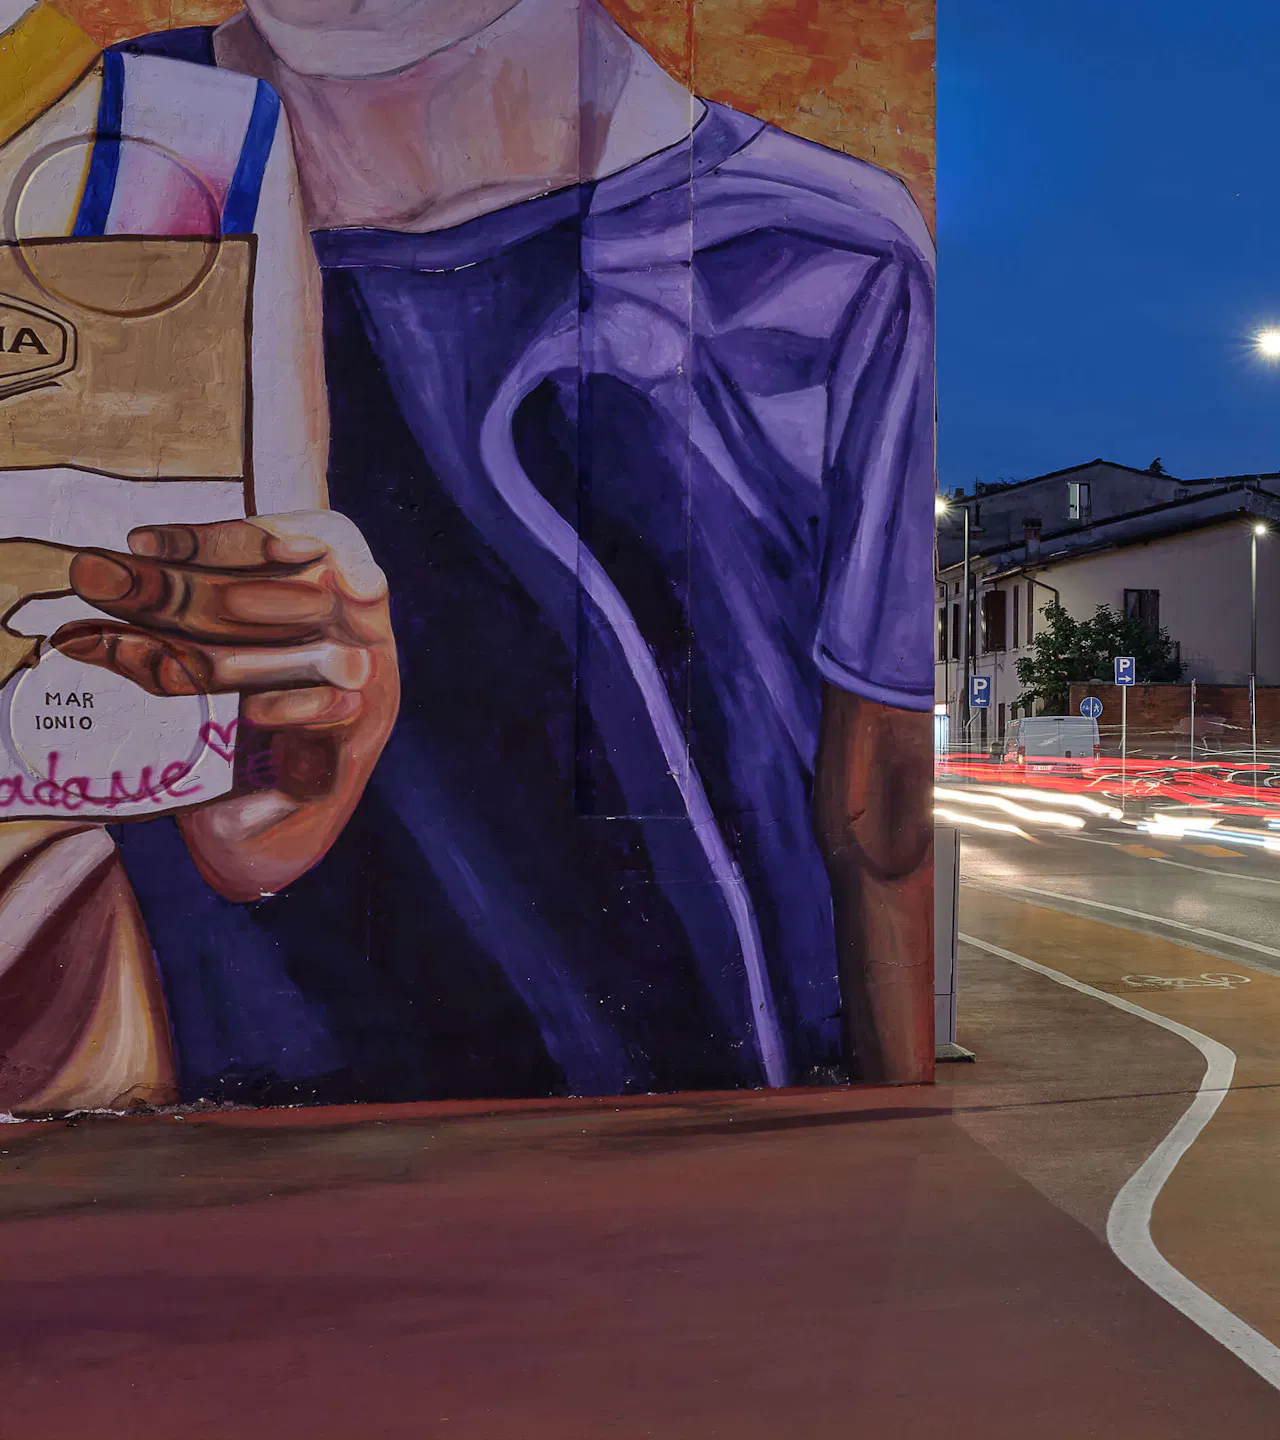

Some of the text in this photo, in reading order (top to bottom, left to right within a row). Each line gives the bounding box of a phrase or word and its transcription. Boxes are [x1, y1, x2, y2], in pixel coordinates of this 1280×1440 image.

[1119, 659, 1130, 672] P
[973, 678, 988, 695] P
[45, 691, 94, 709] MAR
[35, 715, 92, 730] IONIO
